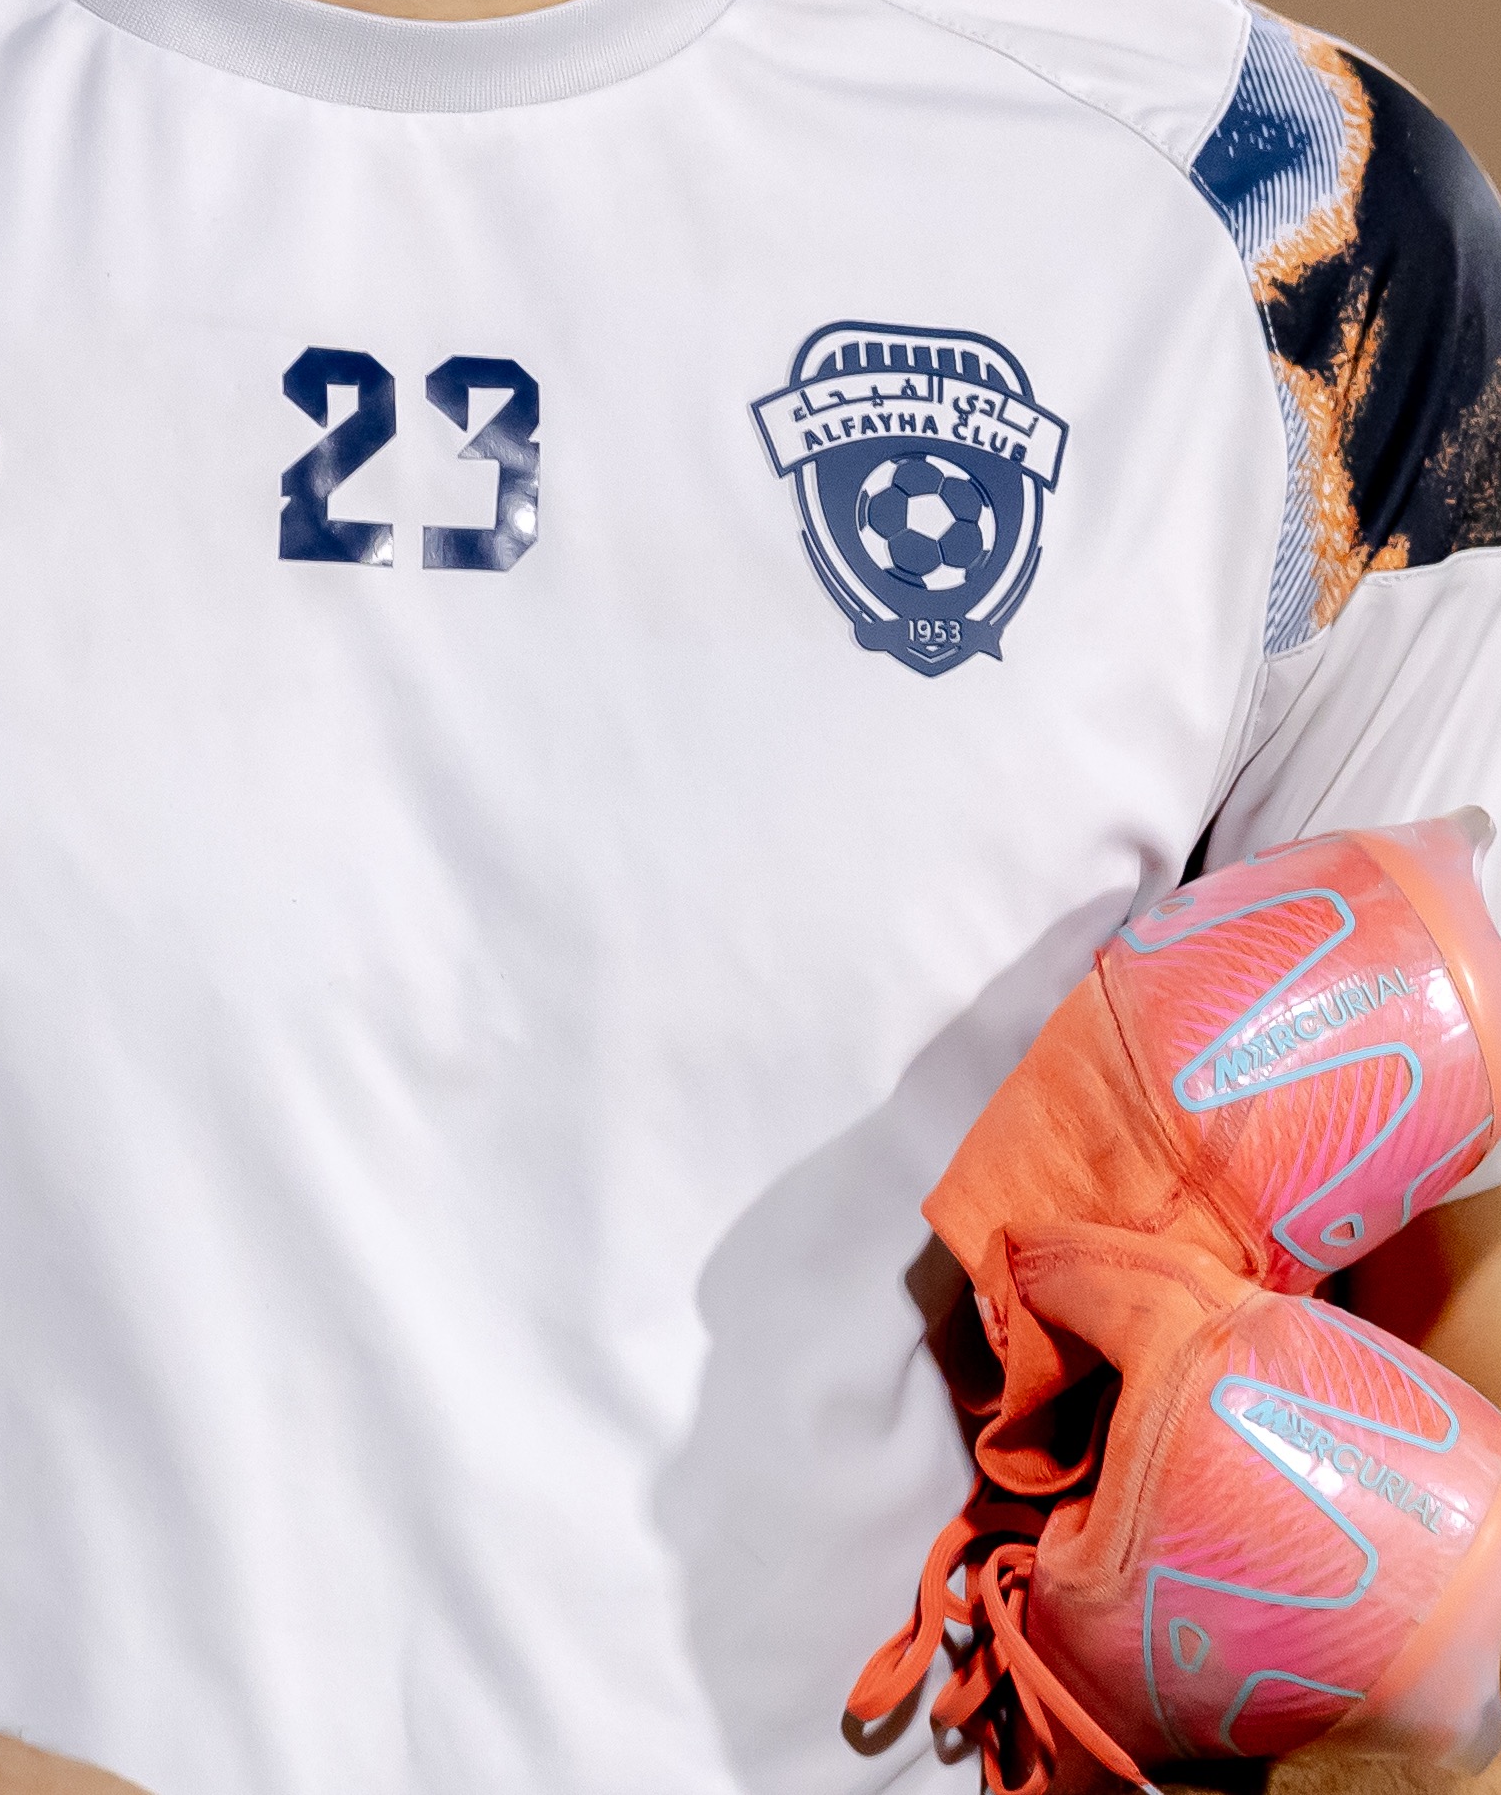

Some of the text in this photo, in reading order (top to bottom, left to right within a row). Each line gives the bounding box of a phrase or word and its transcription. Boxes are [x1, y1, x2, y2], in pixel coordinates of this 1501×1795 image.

[278, 345, 540, 572] 23
[802, 411, 1028, 463] ALFAYHA CLUB
[952, 393, 1040, 439] نادي
[908, 619, 963, 644] 1953
[1214, 966, 1417, 1092] MERCURIAL
[1242, 1399, 1444, 1536] MERCURIAL
